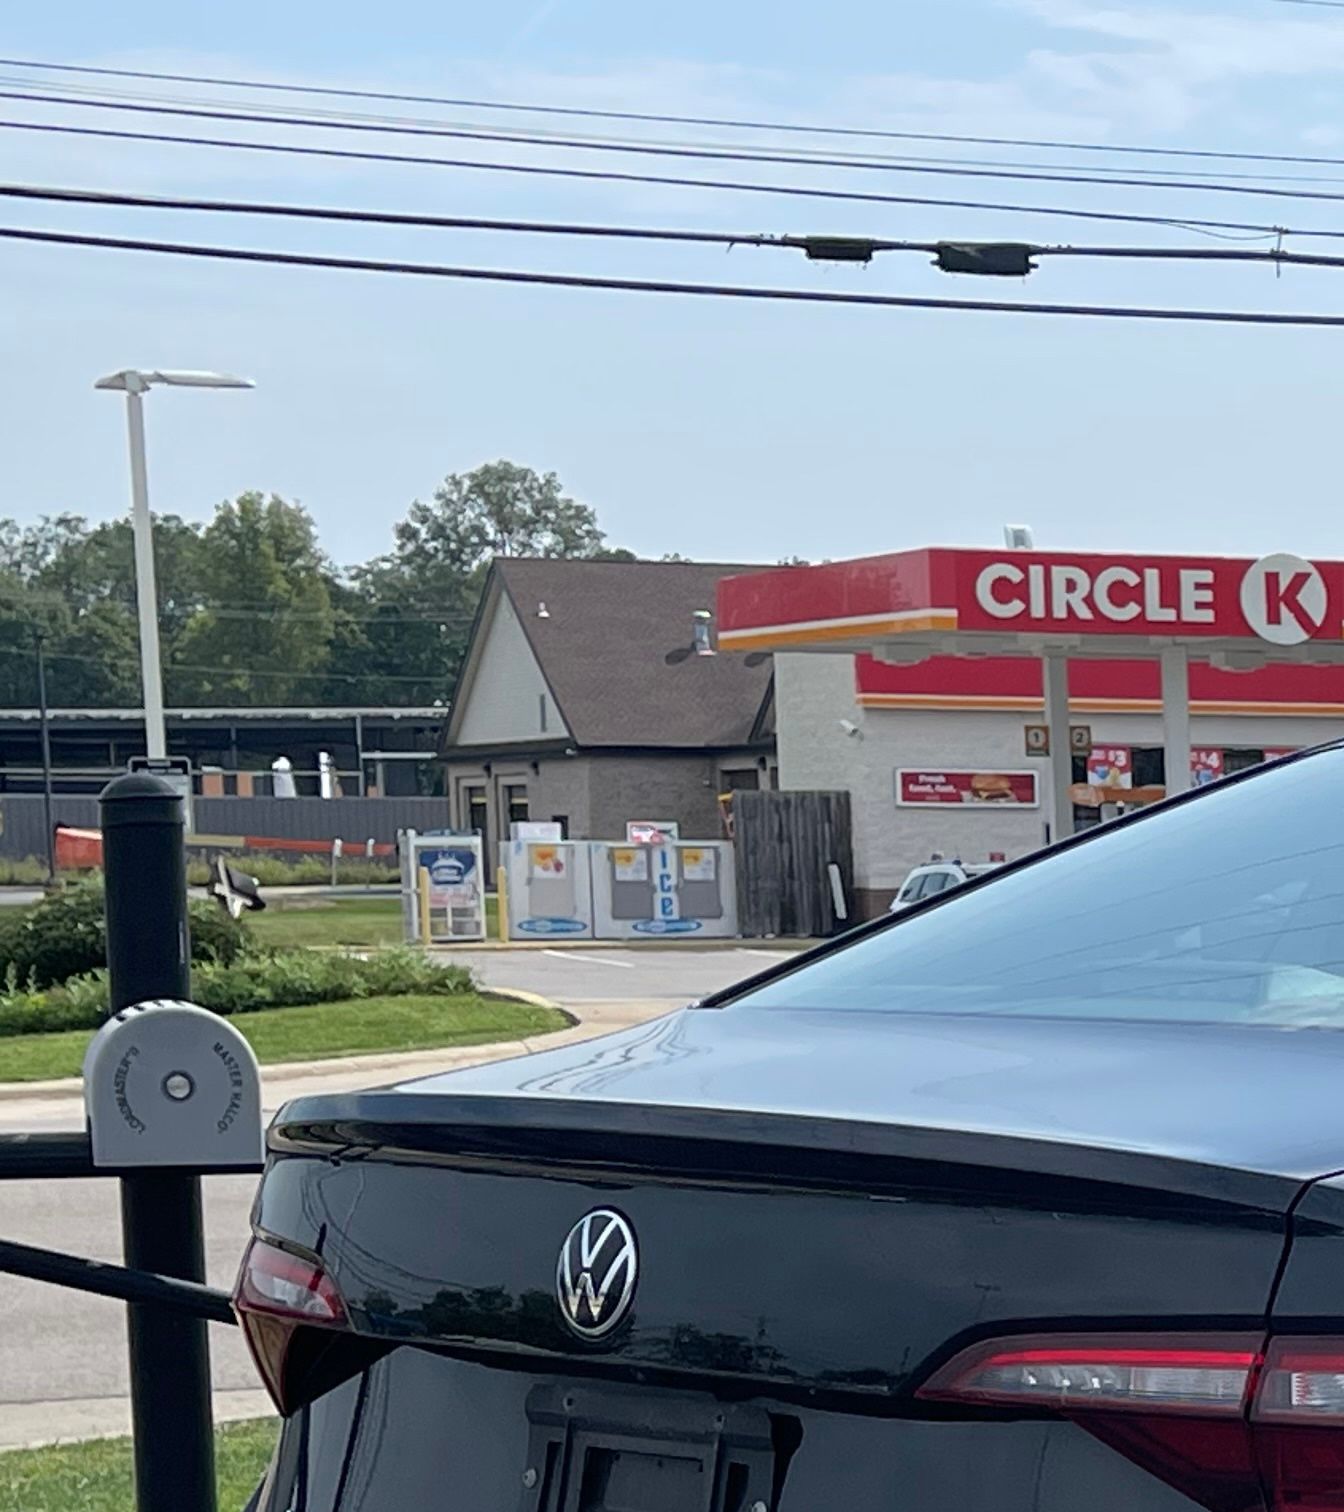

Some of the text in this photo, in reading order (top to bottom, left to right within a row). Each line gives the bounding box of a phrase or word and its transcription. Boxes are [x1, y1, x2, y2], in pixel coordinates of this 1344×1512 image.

[974, 562, 1323, 638] CIRCLE K
[211, 1041, 243, 1088] MASTER
